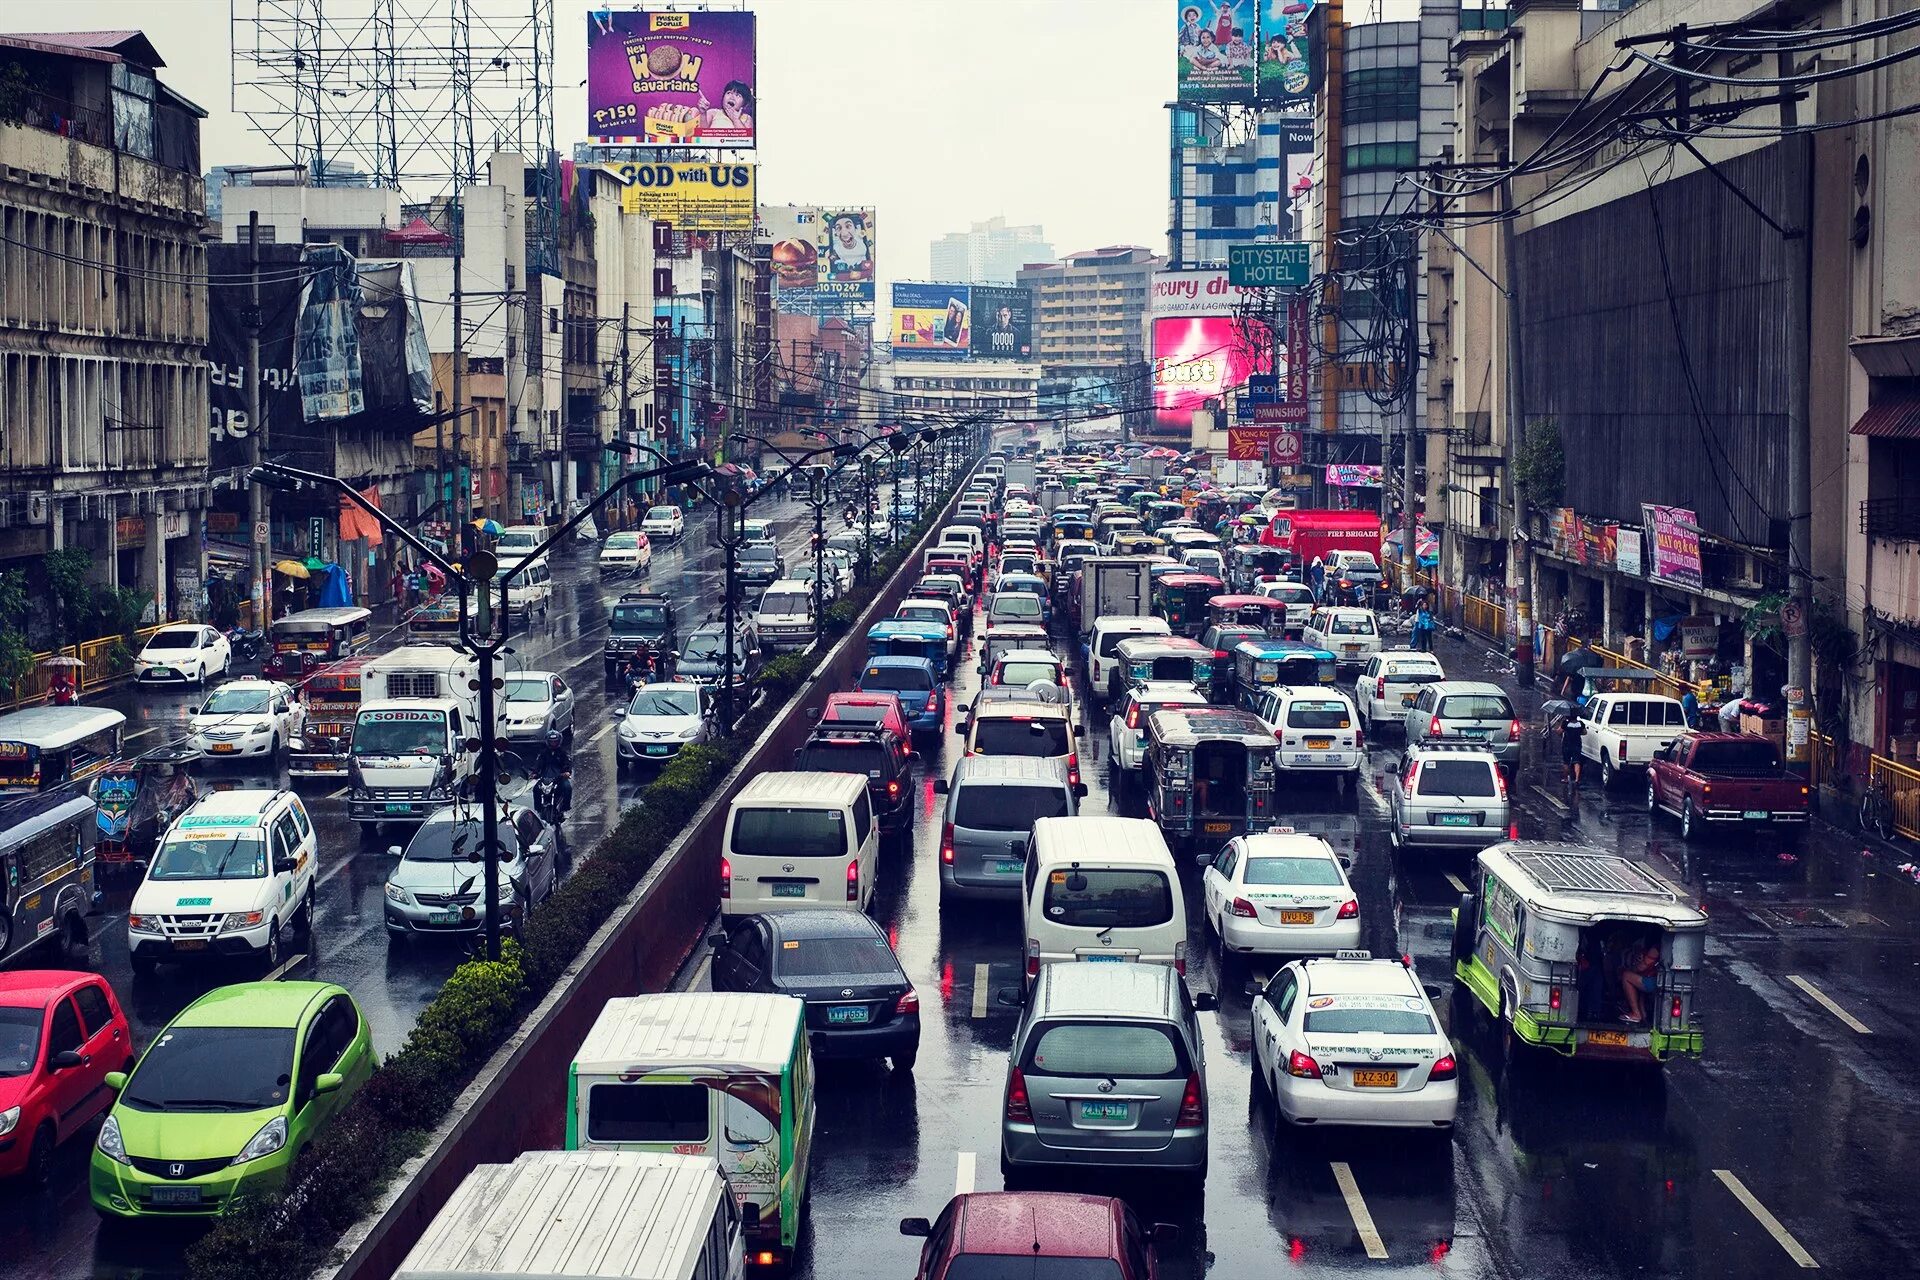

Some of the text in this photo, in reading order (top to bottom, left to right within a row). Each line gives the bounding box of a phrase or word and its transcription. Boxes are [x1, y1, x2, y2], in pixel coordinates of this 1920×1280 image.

[620, 165, 749, 187] GOD with US
[1231, 249, 1308, 265] CITYSTATE
[1244, 266, 1295, 281] HOTEL
[844, 283, 860, 292] 247
[991, 332, 1015, 346] 10000
[1253, 385, 1274, 394] BDO
[1255, 407, 1307, 419] PAWNSHOP
[1239, 430, 1258, 438] HONG
[1327, 530, 1345, 538] FIRE
[1345, 530, 1379, 538] BRIGADE
[1658, 533, 1673, 548] MAY
[374, 712, 430, 721] SOBIDA
[1355, 1071, 1397, 1082] TXZ 304
